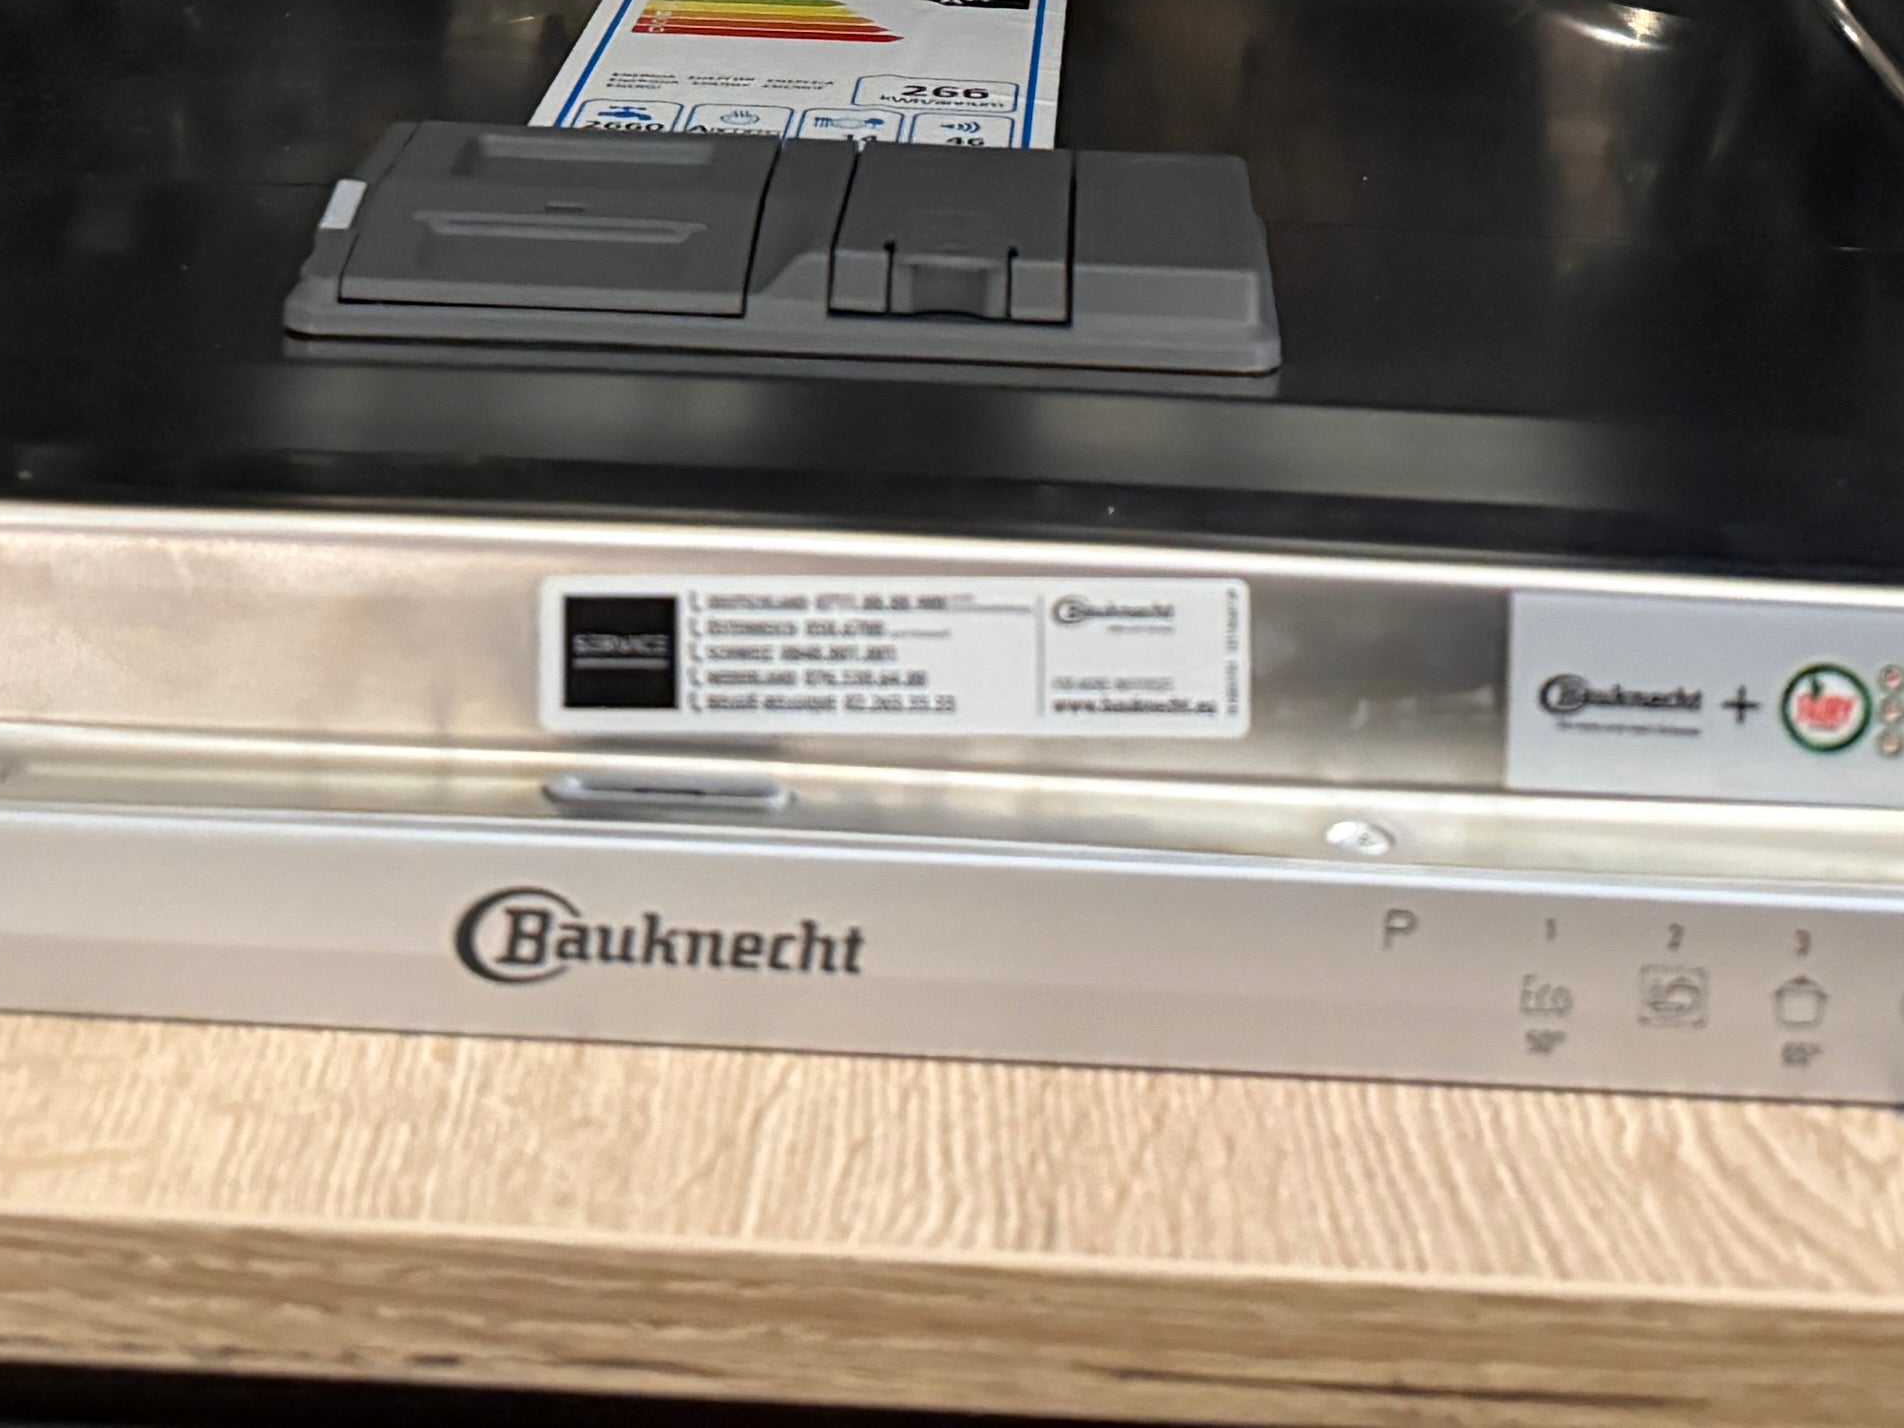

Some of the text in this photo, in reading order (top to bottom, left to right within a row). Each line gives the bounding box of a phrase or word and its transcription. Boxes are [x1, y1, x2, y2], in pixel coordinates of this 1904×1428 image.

[901, 84, 990, 100] 266
[453, 887, 866, 984] Bauknecht
[1383, 908, 1418, 951] P
